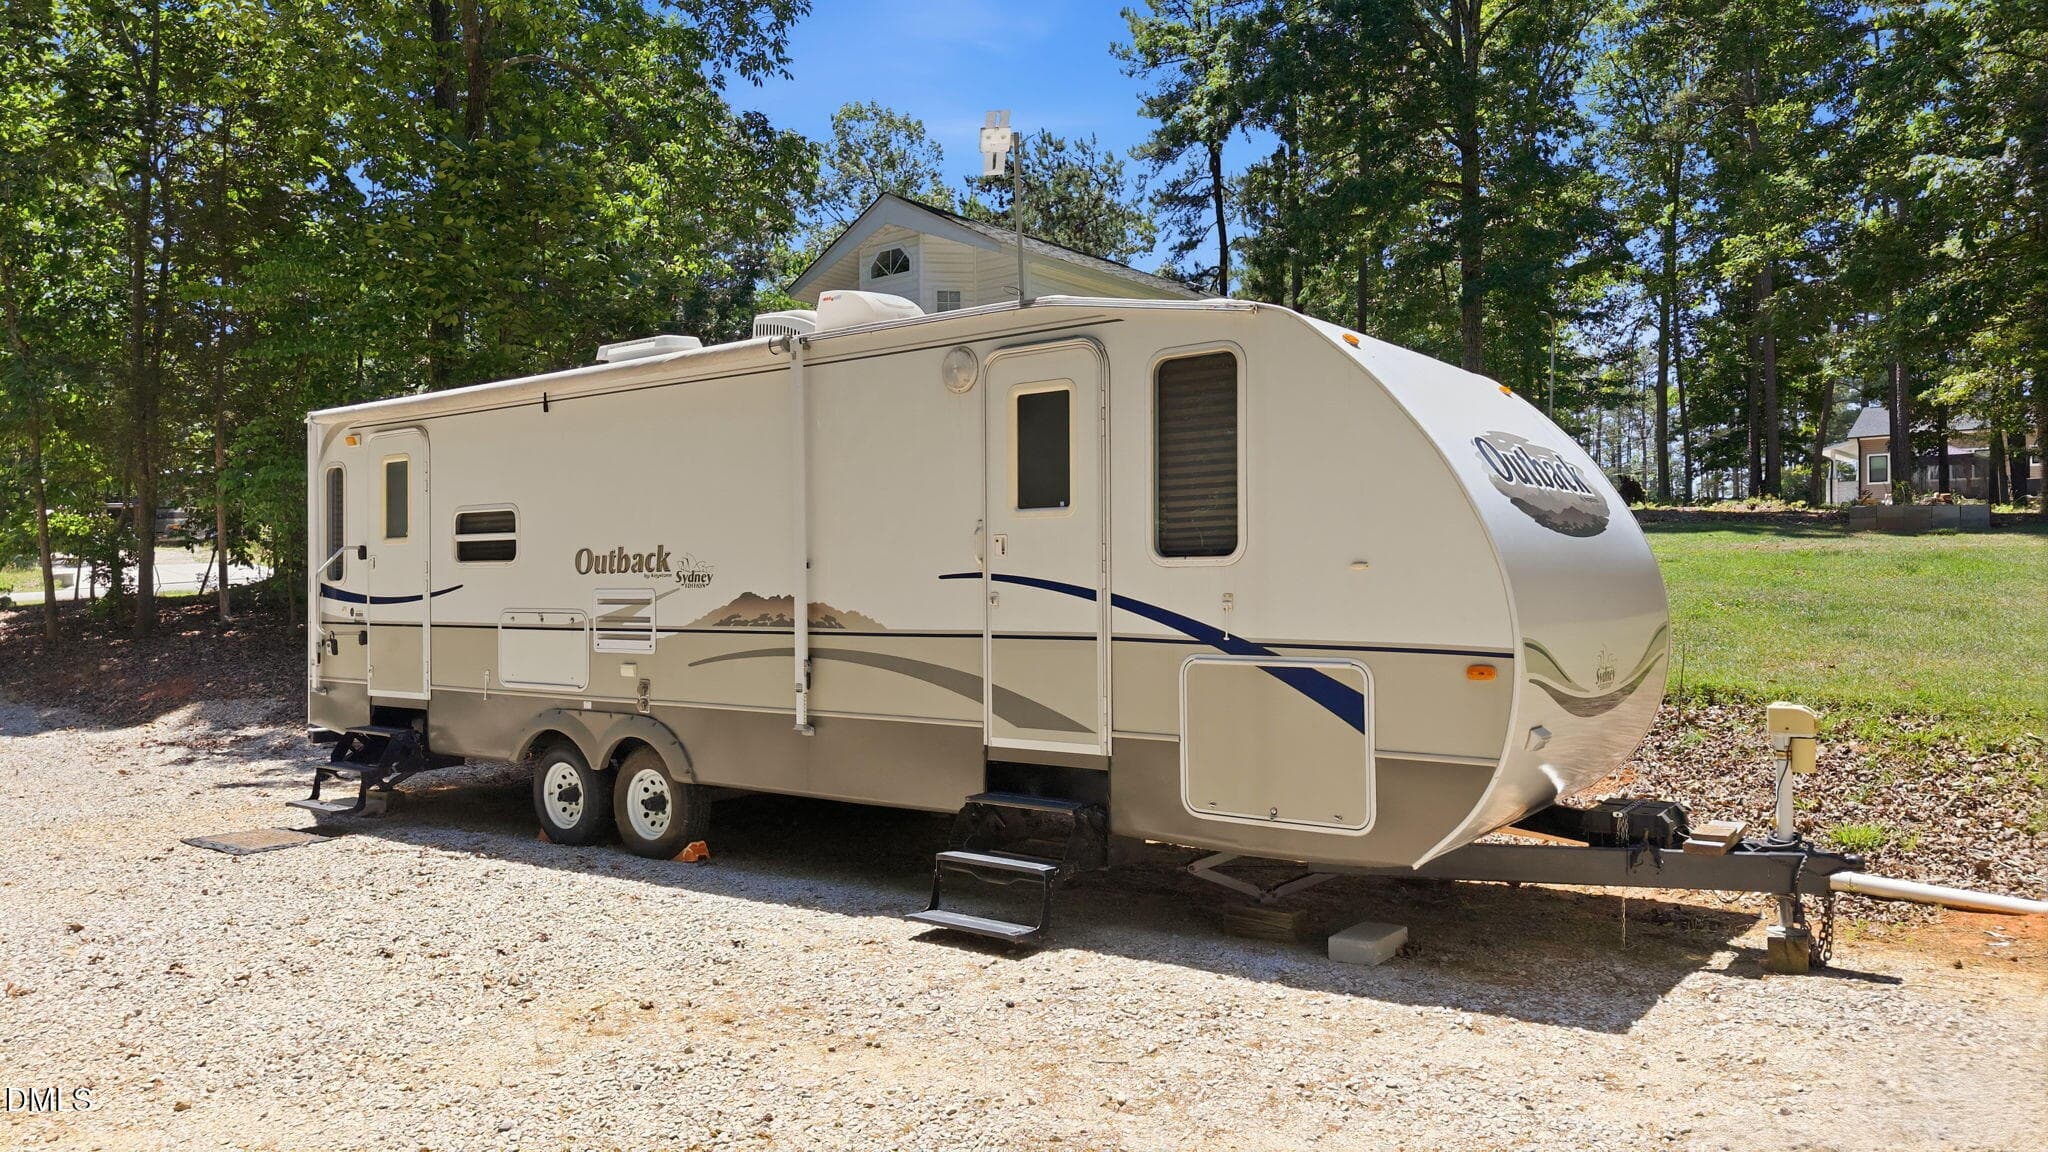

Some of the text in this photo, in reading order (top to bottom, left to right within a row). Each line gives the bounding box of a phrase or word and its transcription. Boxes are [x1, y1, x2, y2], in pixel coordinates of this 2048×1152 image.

[1475, 437, 1592, 495] Outback
[575, 545, 671, 575] Outback
[675, 570, 713, 586] Sydney
